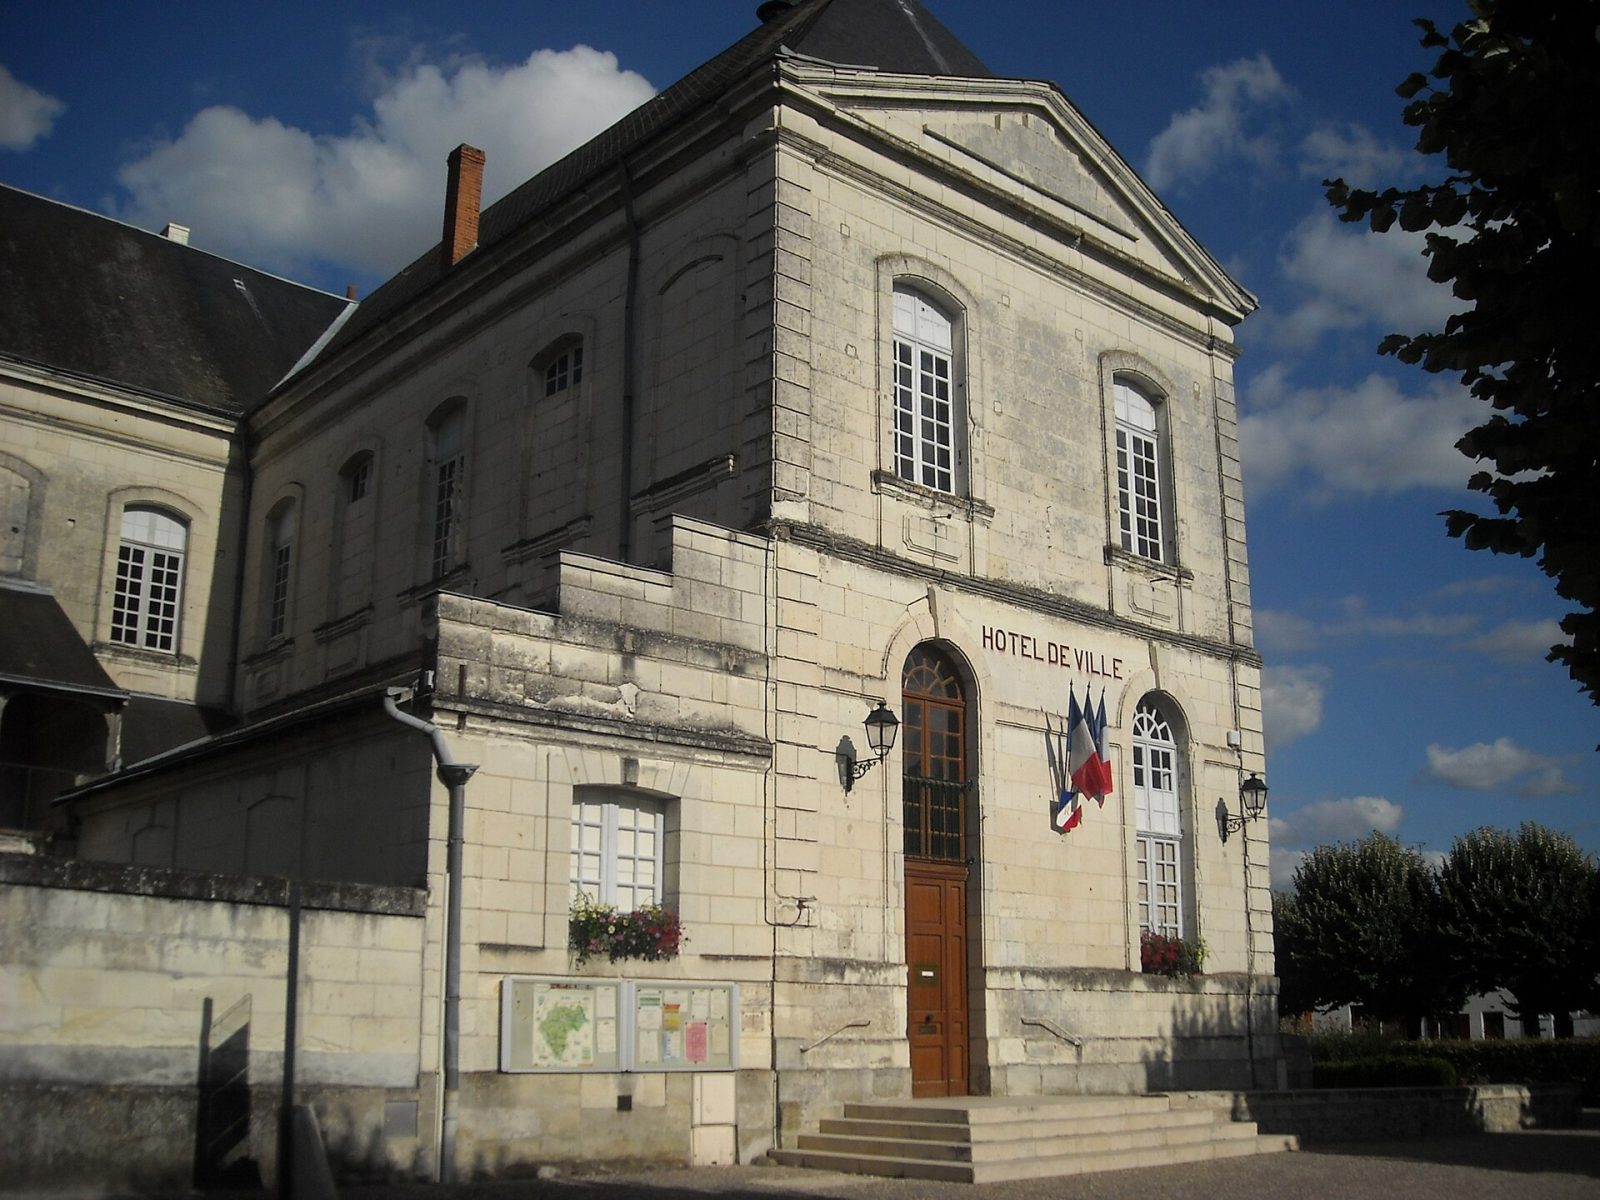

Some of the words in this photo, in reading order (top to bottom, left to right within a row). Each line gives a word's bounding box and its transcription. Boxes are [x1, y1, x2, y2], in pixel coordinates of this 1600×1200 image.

[982, 625, 1044, 662] HOTEL
[1048, 641, 1071, 669] DE
[1074, 648, 1123, 680] VILLE
